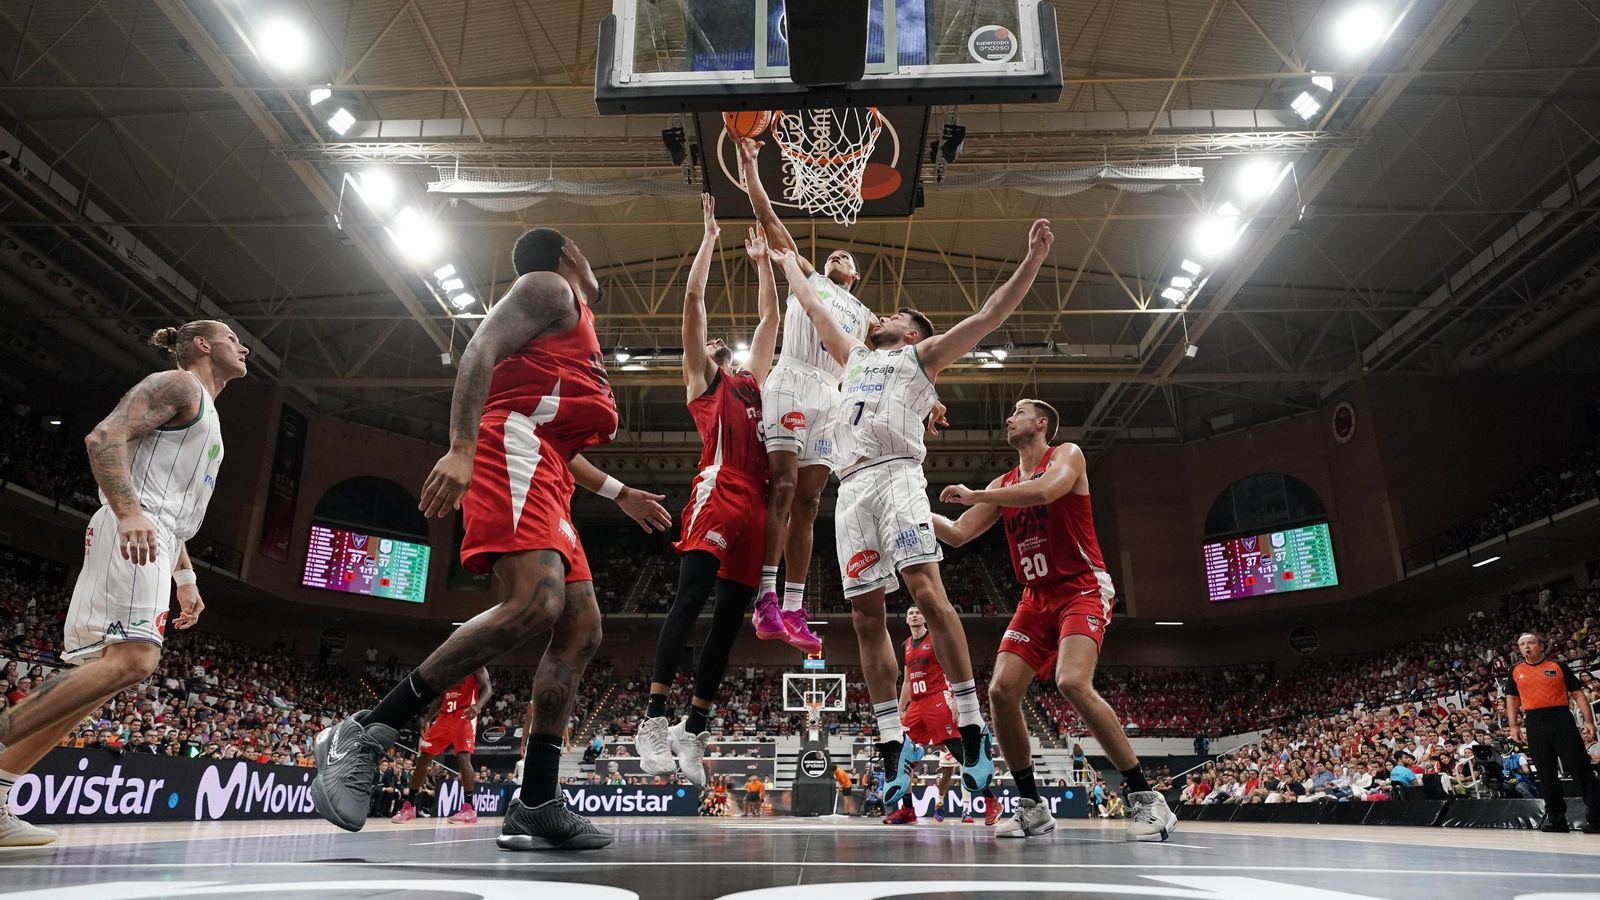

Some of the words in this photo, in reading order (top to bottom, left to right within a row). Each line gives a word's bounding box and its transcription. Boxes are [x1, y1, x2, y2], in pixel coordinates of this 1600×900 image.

[863, 364, 895, 376] Uncaja
[350, 554, 362, 564] 37
[378, 558, 390, 568] 37
[1246, 557, 1257, 566] 37
[1275, 552, 1286, 562] 37
[359, 566, 379, 575] 1:13
[1020, 552, 1048, 581] 20
[1257, 565, 1278, 574] 1:13
[913, 680, 927, 695] 00
[458, 785, 500, 812] Mvistar
[563, 788, 673, 813] Movistar
